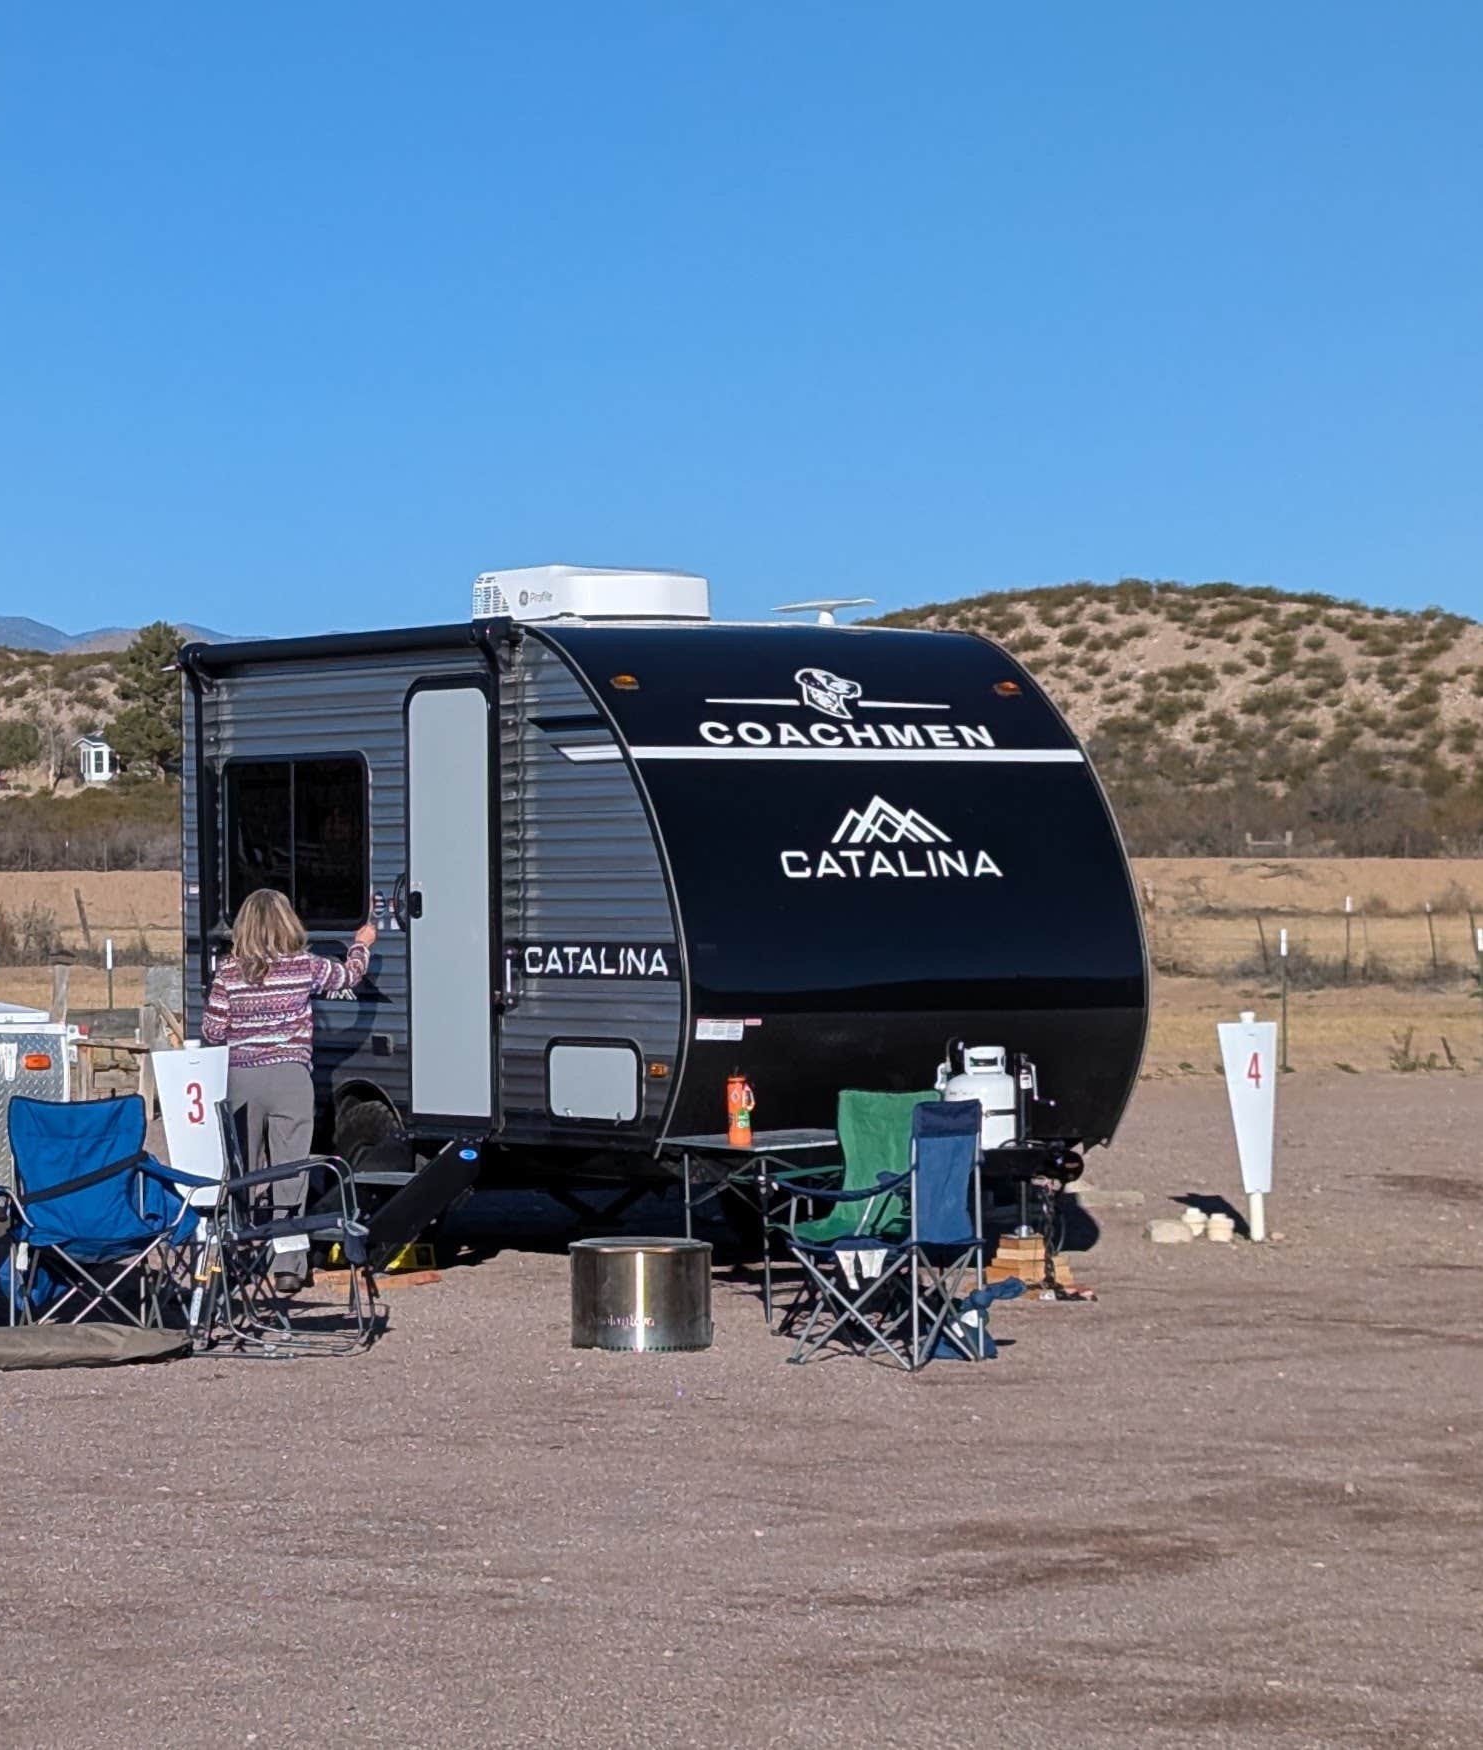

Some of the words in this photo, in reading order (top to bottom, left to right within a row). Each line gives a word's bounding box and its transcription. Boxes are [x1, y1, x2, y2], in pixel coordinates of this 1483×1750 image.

[699, 722, 995, 747] COACHMEN
[780, 850, 1003, 878] CATALINA
[525, 947, 669, 976] CATALINA
[1247, 1052, 1261, 1089] 4
[186, 1081, 205, 1124] 3
